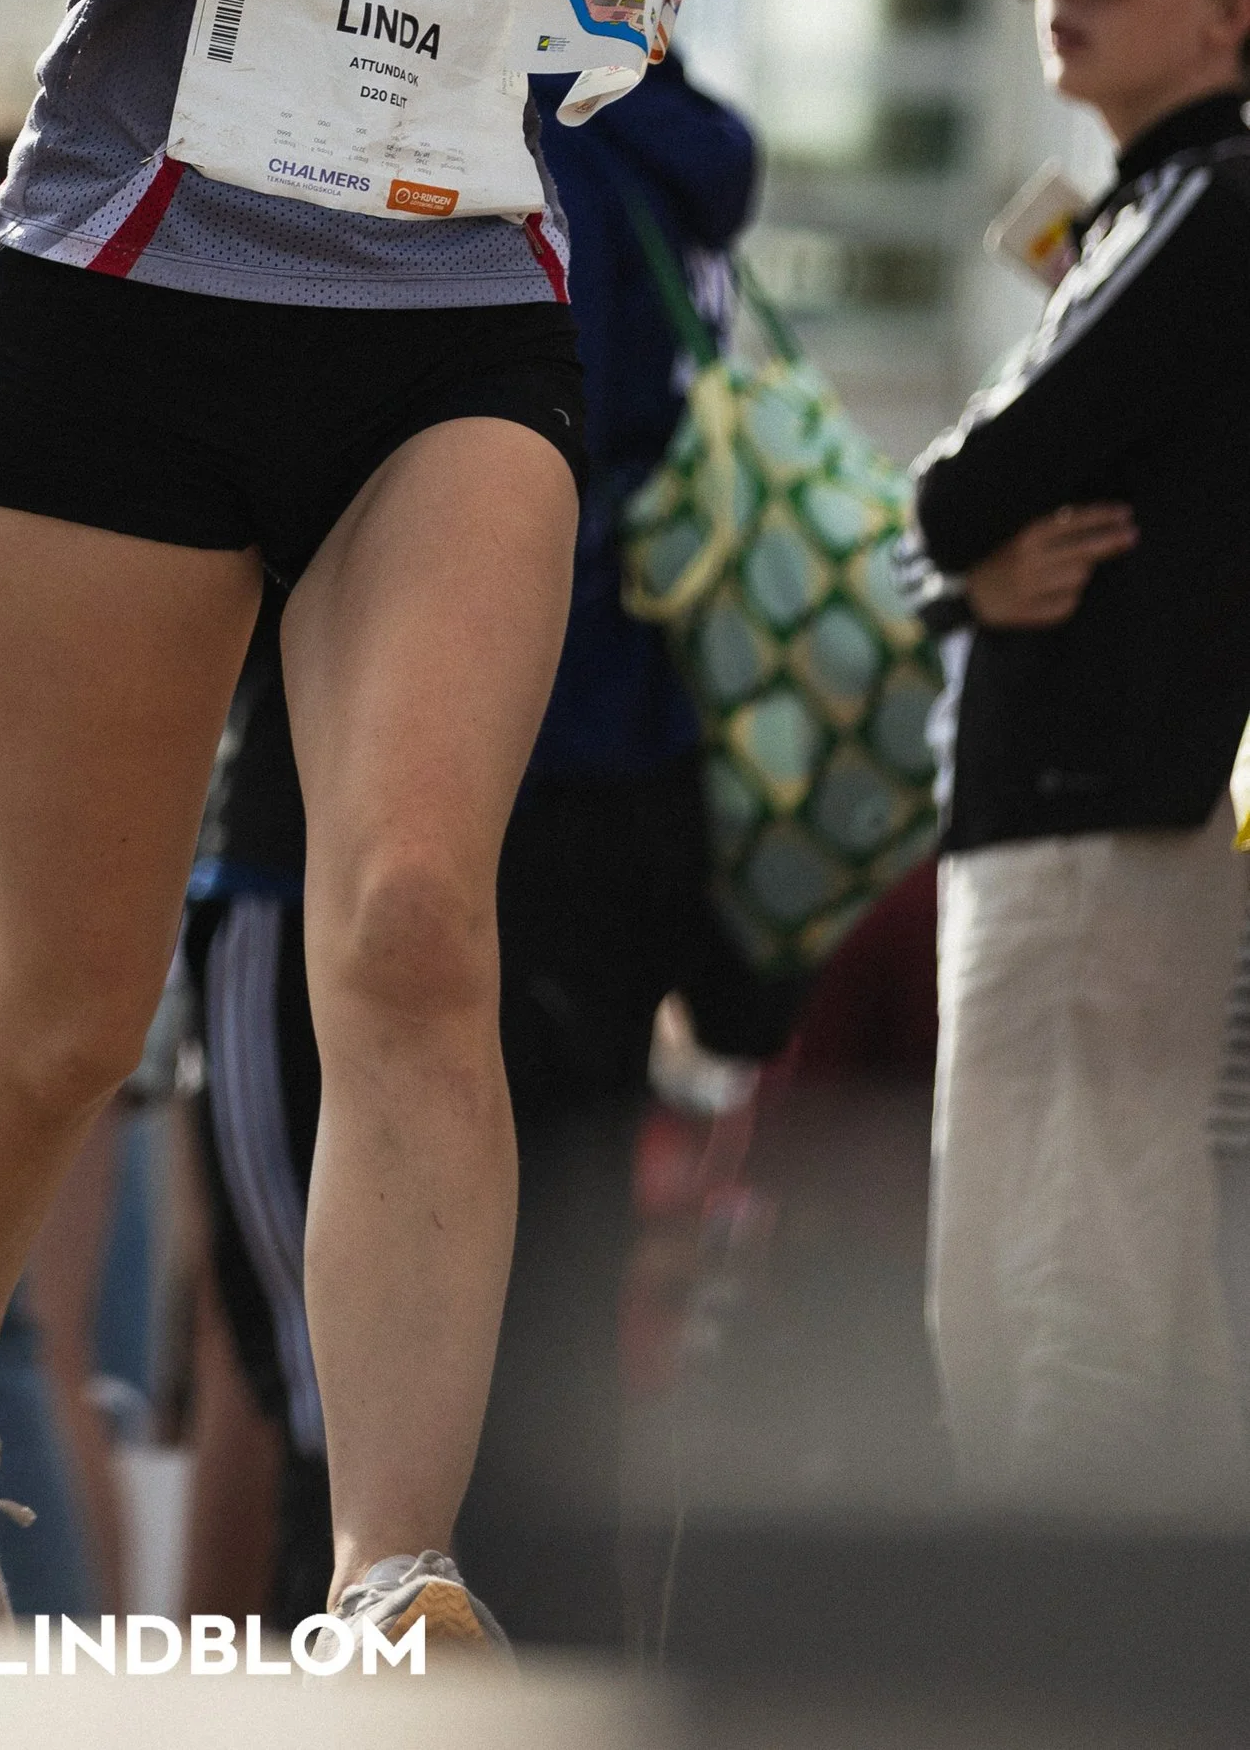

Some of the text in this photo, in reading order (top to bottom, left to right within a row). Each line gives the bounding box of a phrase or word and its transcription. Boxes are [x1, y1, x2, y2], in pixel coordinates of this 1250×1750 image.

[350, 57, 419, 87] ATTUNDA OK
[360, 86, 408, 109] D20 ELIT
[266, 175, 301, 189] TEKNISKA
[268, 158, 371, 192] CHALMERS
[412, 190, 452, 207] O-RINGEN
